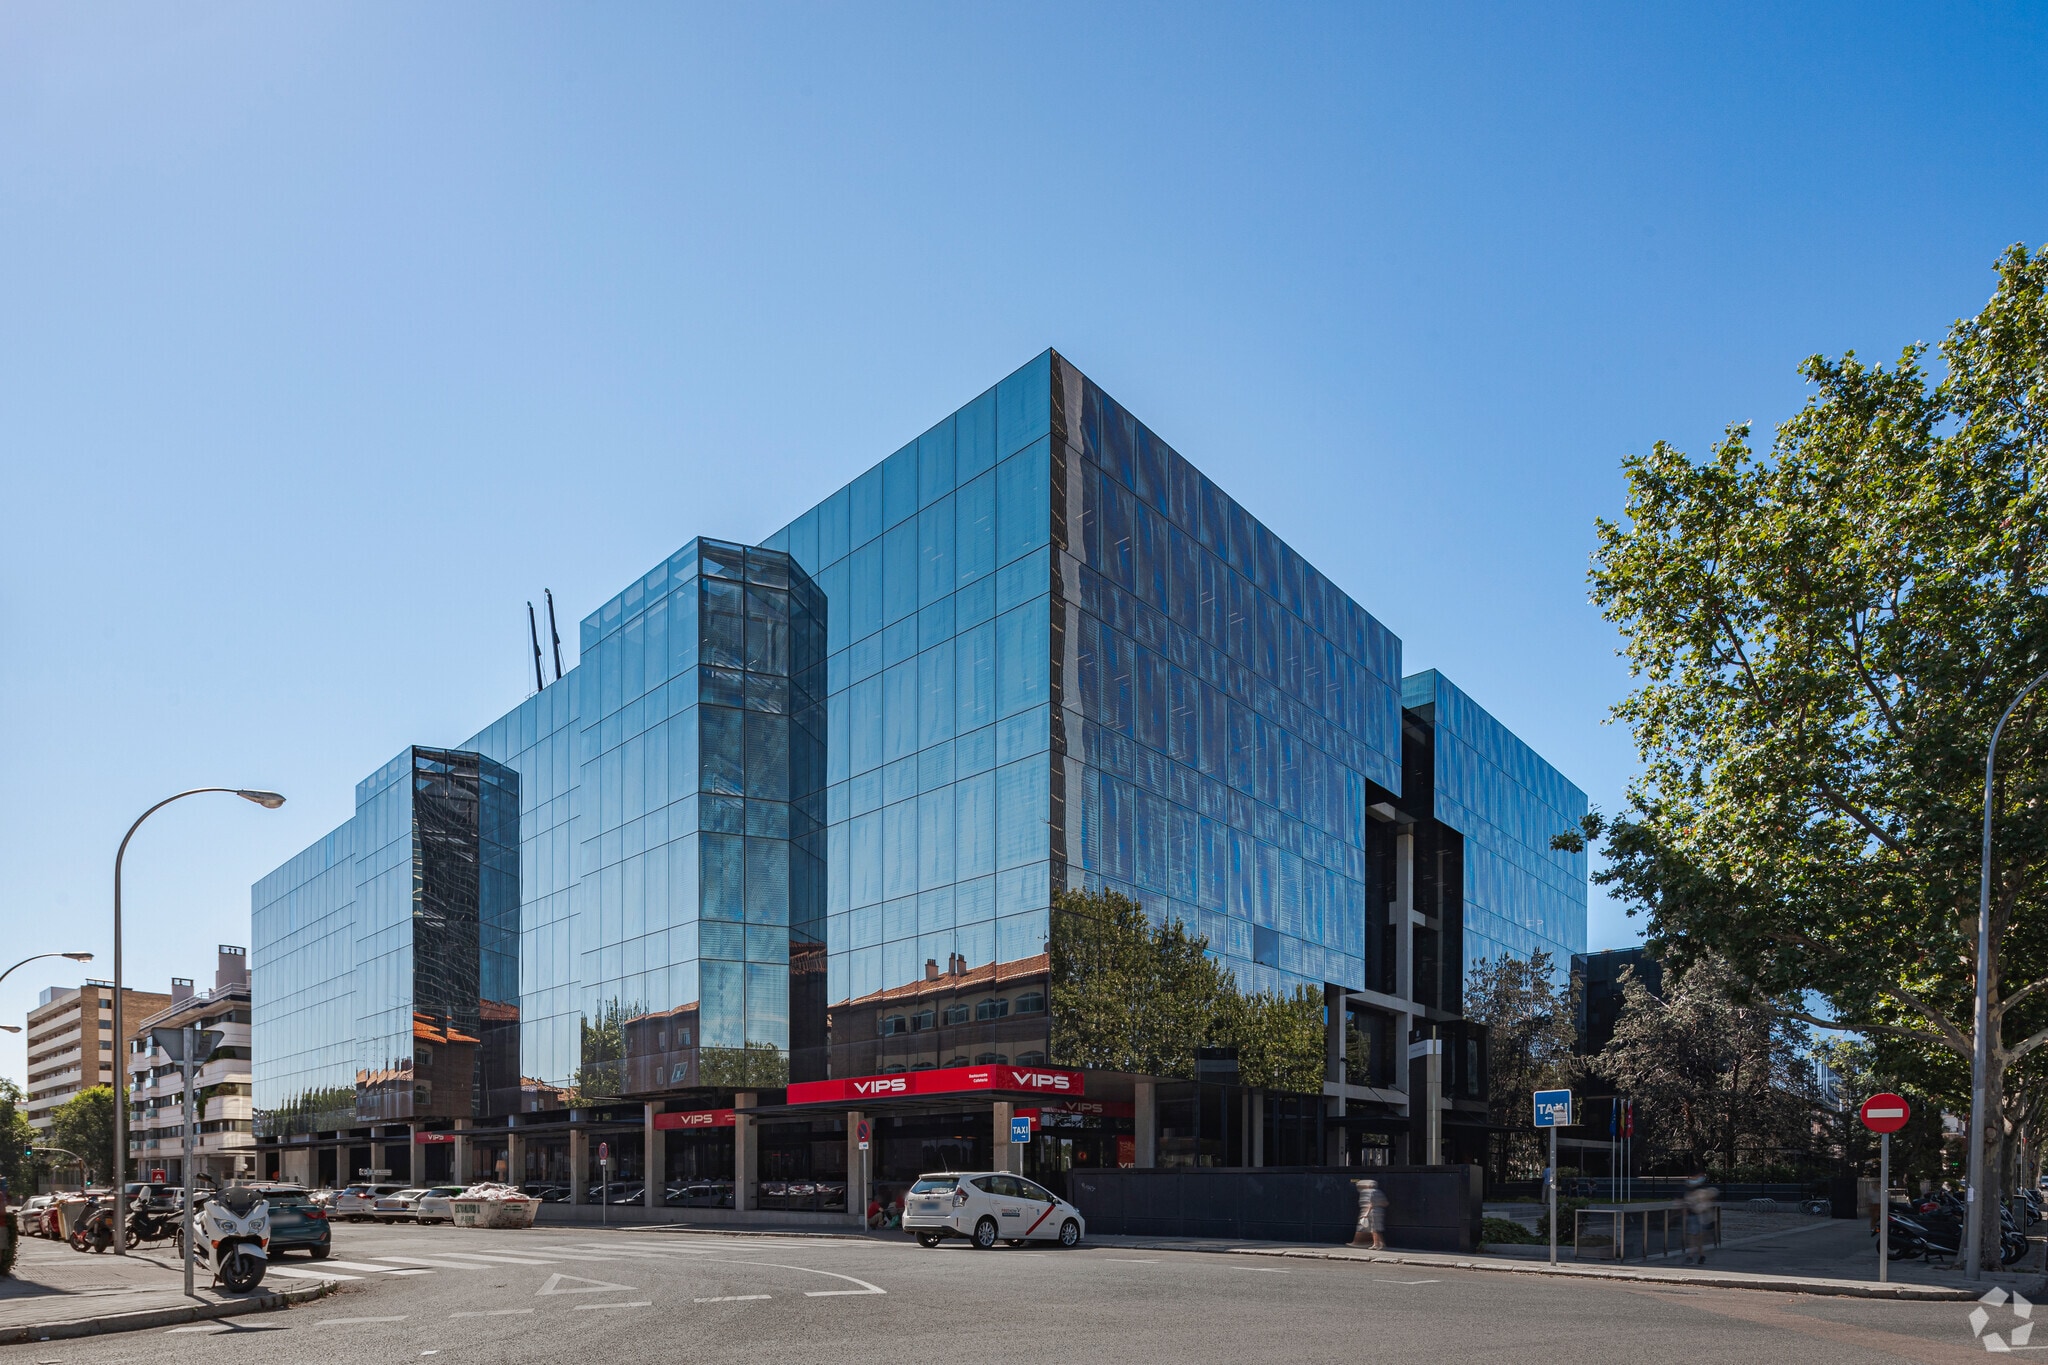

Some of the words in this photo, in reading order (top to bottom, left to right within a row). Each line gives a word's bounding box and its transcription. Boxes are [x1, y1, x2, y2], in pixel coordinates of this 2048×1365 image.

[854, 1078, 907, 1094] VIPS
[1012, 1071, 1070, 1089] VIPS
[1065, 1101, 1103, 1113] VIPS
[681, 1114, 713, 1124] VIPS
[1012, 1125, 1029, 1135] TAXI
